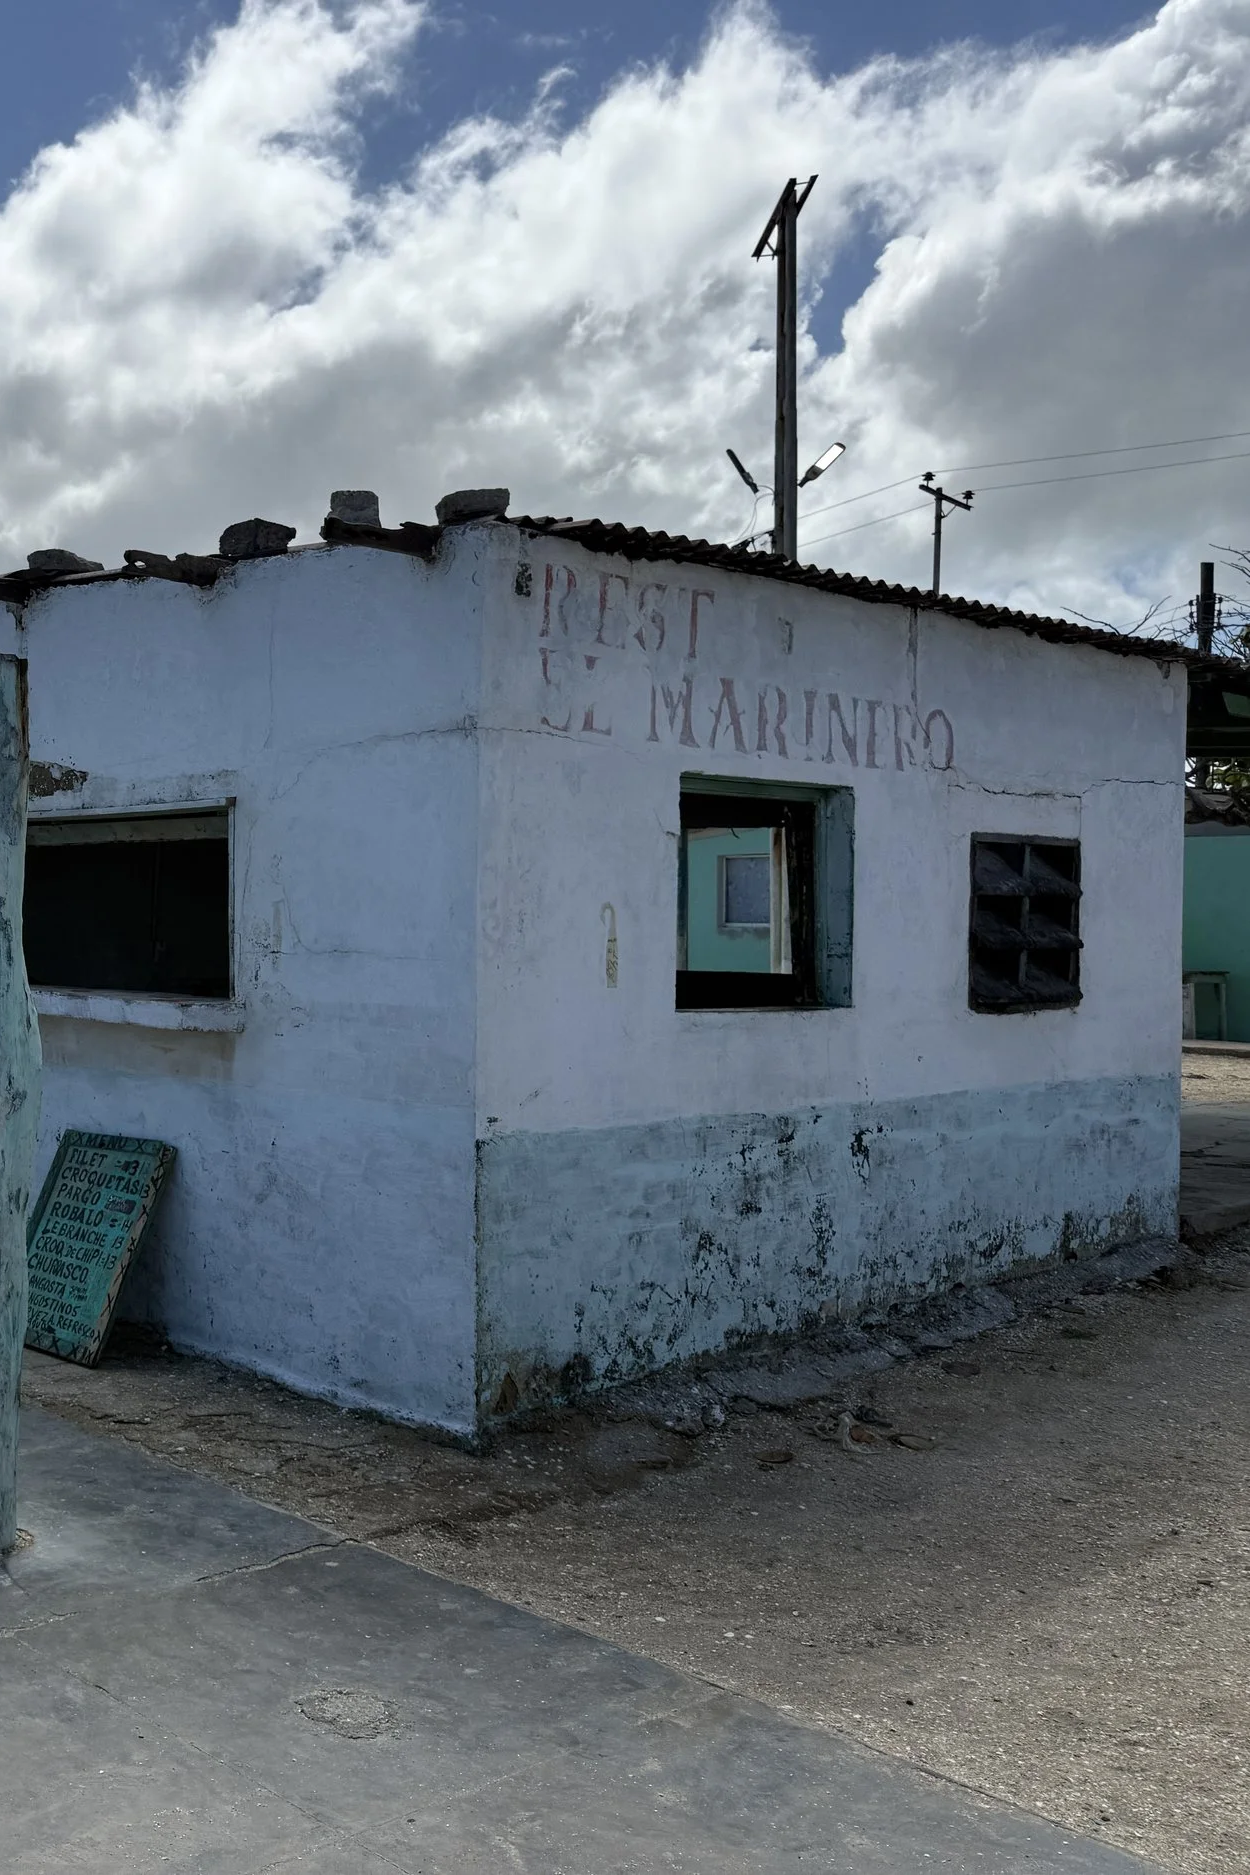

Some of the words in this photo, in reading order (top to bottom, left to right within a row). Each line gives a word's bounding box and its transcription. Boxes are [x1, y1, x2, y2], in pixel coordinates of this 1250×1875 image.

[538, 563, 716, 659] REST
[68, 1148, 108, 1168] FILET
[57, 1183, 102, 1206] PARGO
[61, 1166, 140, 1196] CROQUETAS
[50, 1201, 104, 1228] ROBALO
[41, 1218, 108, 1249] LEBRANCHE
[111, 1235, 125, 1250] 13
[28, 1272, 67, 1300] ANGOSTA
[28, 1290, 81, 1318] NGOSTINOS
